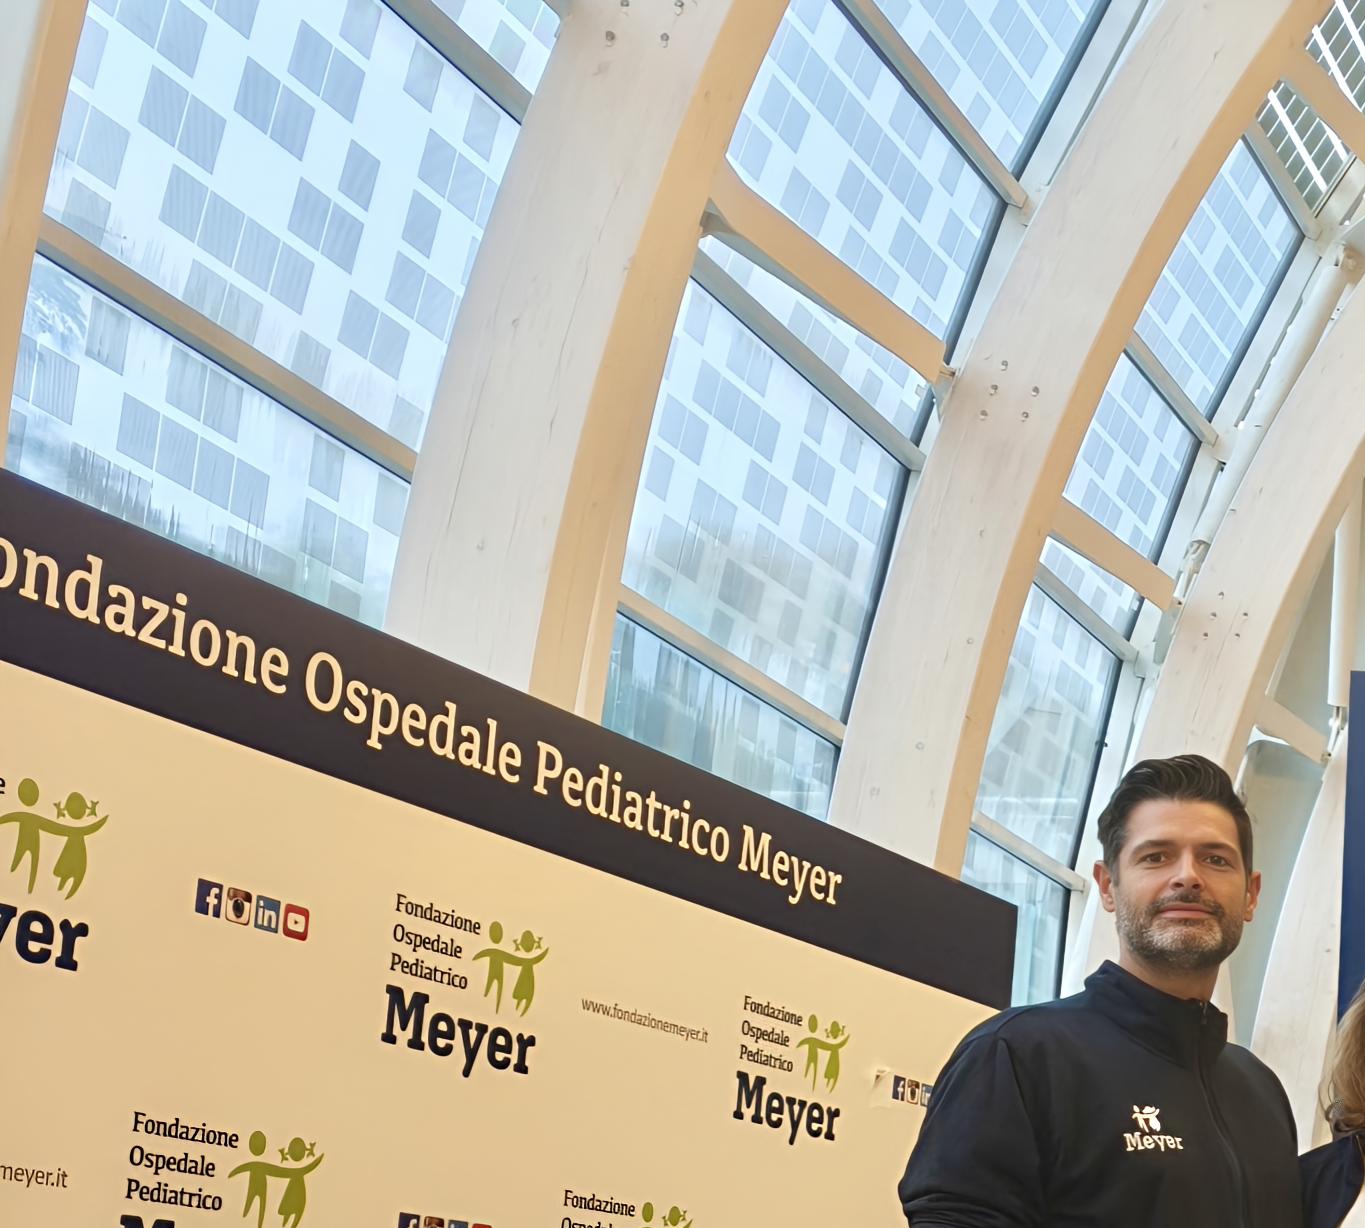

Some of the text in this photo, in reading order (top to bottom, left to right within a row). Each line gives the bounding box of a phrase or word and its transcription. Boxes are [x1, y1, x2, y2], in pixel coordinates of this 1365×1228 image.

[0, 537, 843, 905] ondazione Ospedale Pediatrico Meyer
[395, 893, 481, 935] Fondazione
[393, 924, 463, 959] Ospedale
[390, 952, 468, 989] Pediatrico
[581, 997, 708, 1043] www.fondazionemeyer.it
[744, 995, 803, 1026] Fondazione
[381, 984, 536, 1078] Meyer
[741, 1020, 790, 1047] Ospedale
[739, 1044, 793, 1072] Pediatrico
[733, 1070, 840, 1146] Meyer
[132, 1111, 239, 1149] Fondazione
[1123, 1132, 1184, 1151] Meyer
[0, 1164, 68, 1188] meyer.it
[129, 1145, 216, 1178] Ospedale
[125, 1178, 223, 1211] Pediatrico
[563, 1189, 635, 1218] Fondazione
